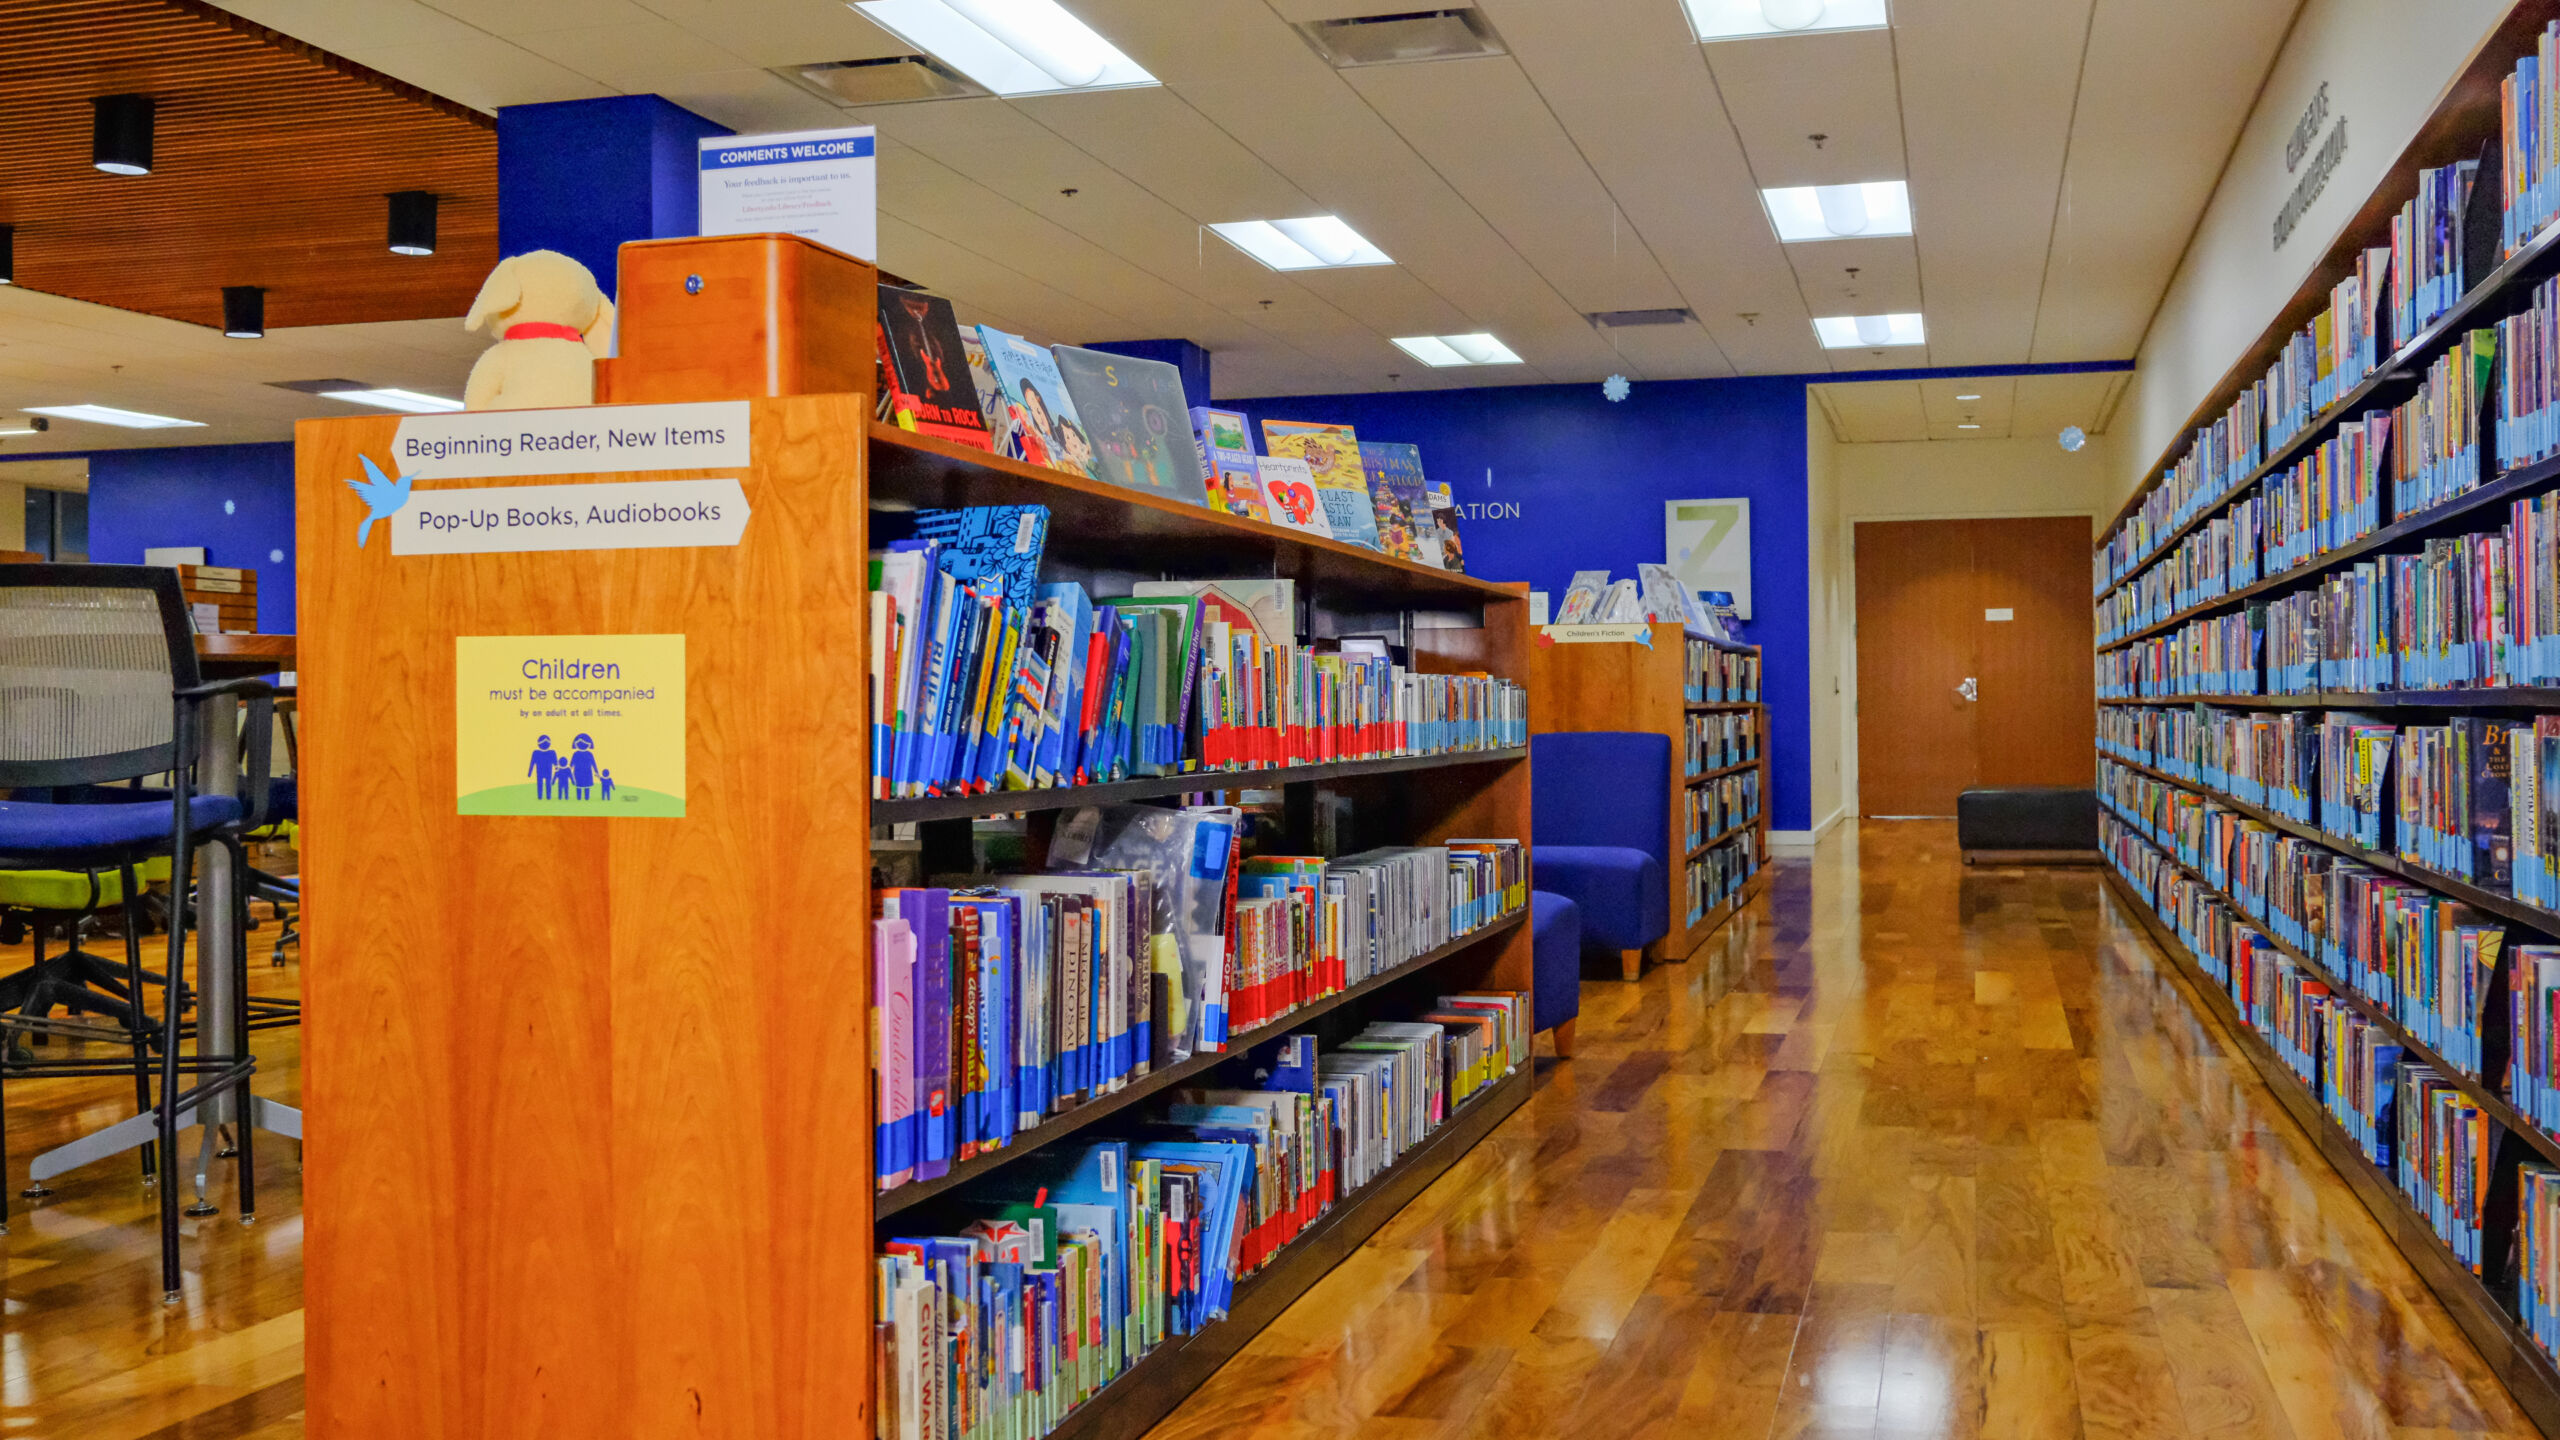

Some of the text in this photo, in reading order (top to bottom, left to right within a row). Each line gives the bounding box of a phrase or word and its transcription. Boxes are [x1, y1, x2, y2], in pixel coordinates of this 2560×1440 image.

[720, 142, 855, 164] COMMENTS WELCOME
[724, 179, 742, 190] Your
[744, 176, 779, 188] feedback
[780, 175, 787, 185] is
[788, 172, 829, 186] important
[830, 173, 839, 182] to
[952, 407, 982, 428] ROCK
[405, 425, 726, 460] Beginning Reader, New Items
[1327, 490, 1355, 503] LAST
[1427, 493, 1448, 503] DAMS
[419, 500, 722, 533] Pop-Up Books, Audiobooks
[1323, 503, 1354, 515] ASTIC
[1455, 502, 1520, 521] ATION
[1328, 515, 1352, 528] RAW
[959, 626, 967, 651] YOU'RE
[1189, 628, 1201, 658] Luther
[1566, 630, 1600, 638] Children's
[522, 658, 620, 680] Children
[929, 640, 944, 705] BLUE
[1184, 660, 1195, 697] Martin
[489, 687, 655, 703] must be accompanied
[519, 709, 529, 719] by
[545, 709, 567, 717] adult
[570, 709, 580, 717] at
[583, 709, 593, 717] all
[597, 709, 623, 717] times.
[946, 698, 954, 715] YOU
[2482, 724, 2512, 746] Br
[1226, 892, 1236, 946] Escher
[1142, 927, 1151, 1013] AMERICA
[1078, 1003, 1088, 1041] BEA
[965, 977, 977, 1092] aesop's FABLE
[892, 975, 910, 1120] Cinderella
[920, 1302, 932, 1440] CIVIL WAR
